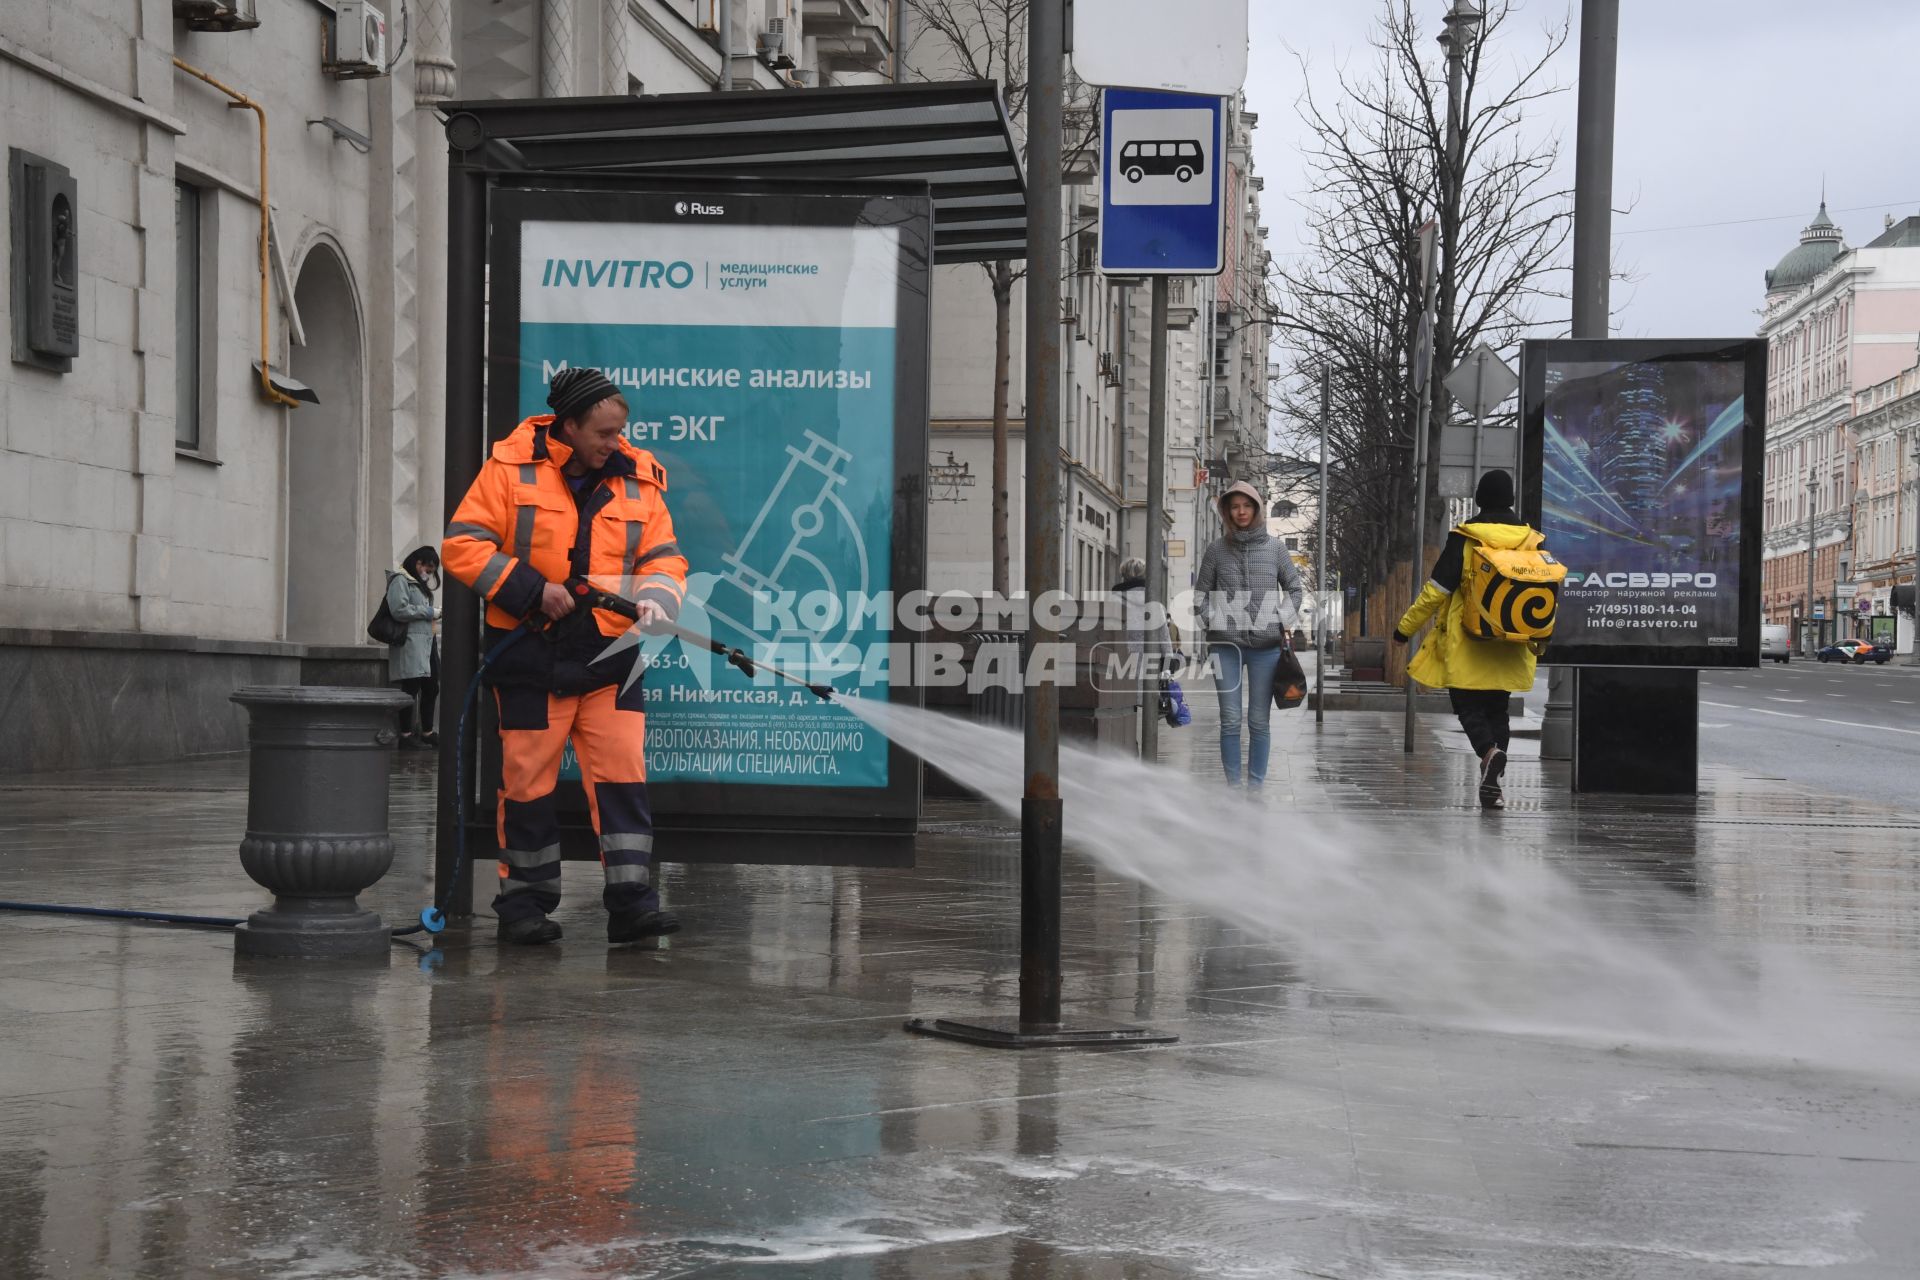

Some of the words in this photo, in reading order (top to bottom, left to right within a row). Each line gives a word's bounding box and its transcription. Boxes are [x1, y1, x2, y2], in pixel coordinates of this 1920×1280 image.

[691, 202, 725, 215] Russ
[542, 258, 694, 289] INVITRO
[720, 262, 818, 276] медицинские
[720, 276, 767, 290] услуги
[542, 359, 741, 389] Мицинские
[749, 368, 871, 389] анализы
[669, 415, 725, 441] ЭКГ
[1564, 572, 1717, 588] РАСВЭРО
[1564, 590, 1609, 598] оператор
[1617, 588, 1666, 598] наружной
[1673, 589, 1717, 598] рекламы
[1587, 604, 1697, 615] +7(495)180-14-04
[1587, 617, 1698, 628] info@rasvero.ru
[671, 684, 784, 707] Никитская,
[789, 691, 808, 707] д.
[645, 728, 761, 751] ИВОПОКАЗАНИЯ.
[764, 730, 863, 754] НЕОБХОДИМО
[643, 751, 732, 775] НСУЛЬТАЦИИ
[736, 752, 840, 776] СПЕЦИАЛИСТА.
